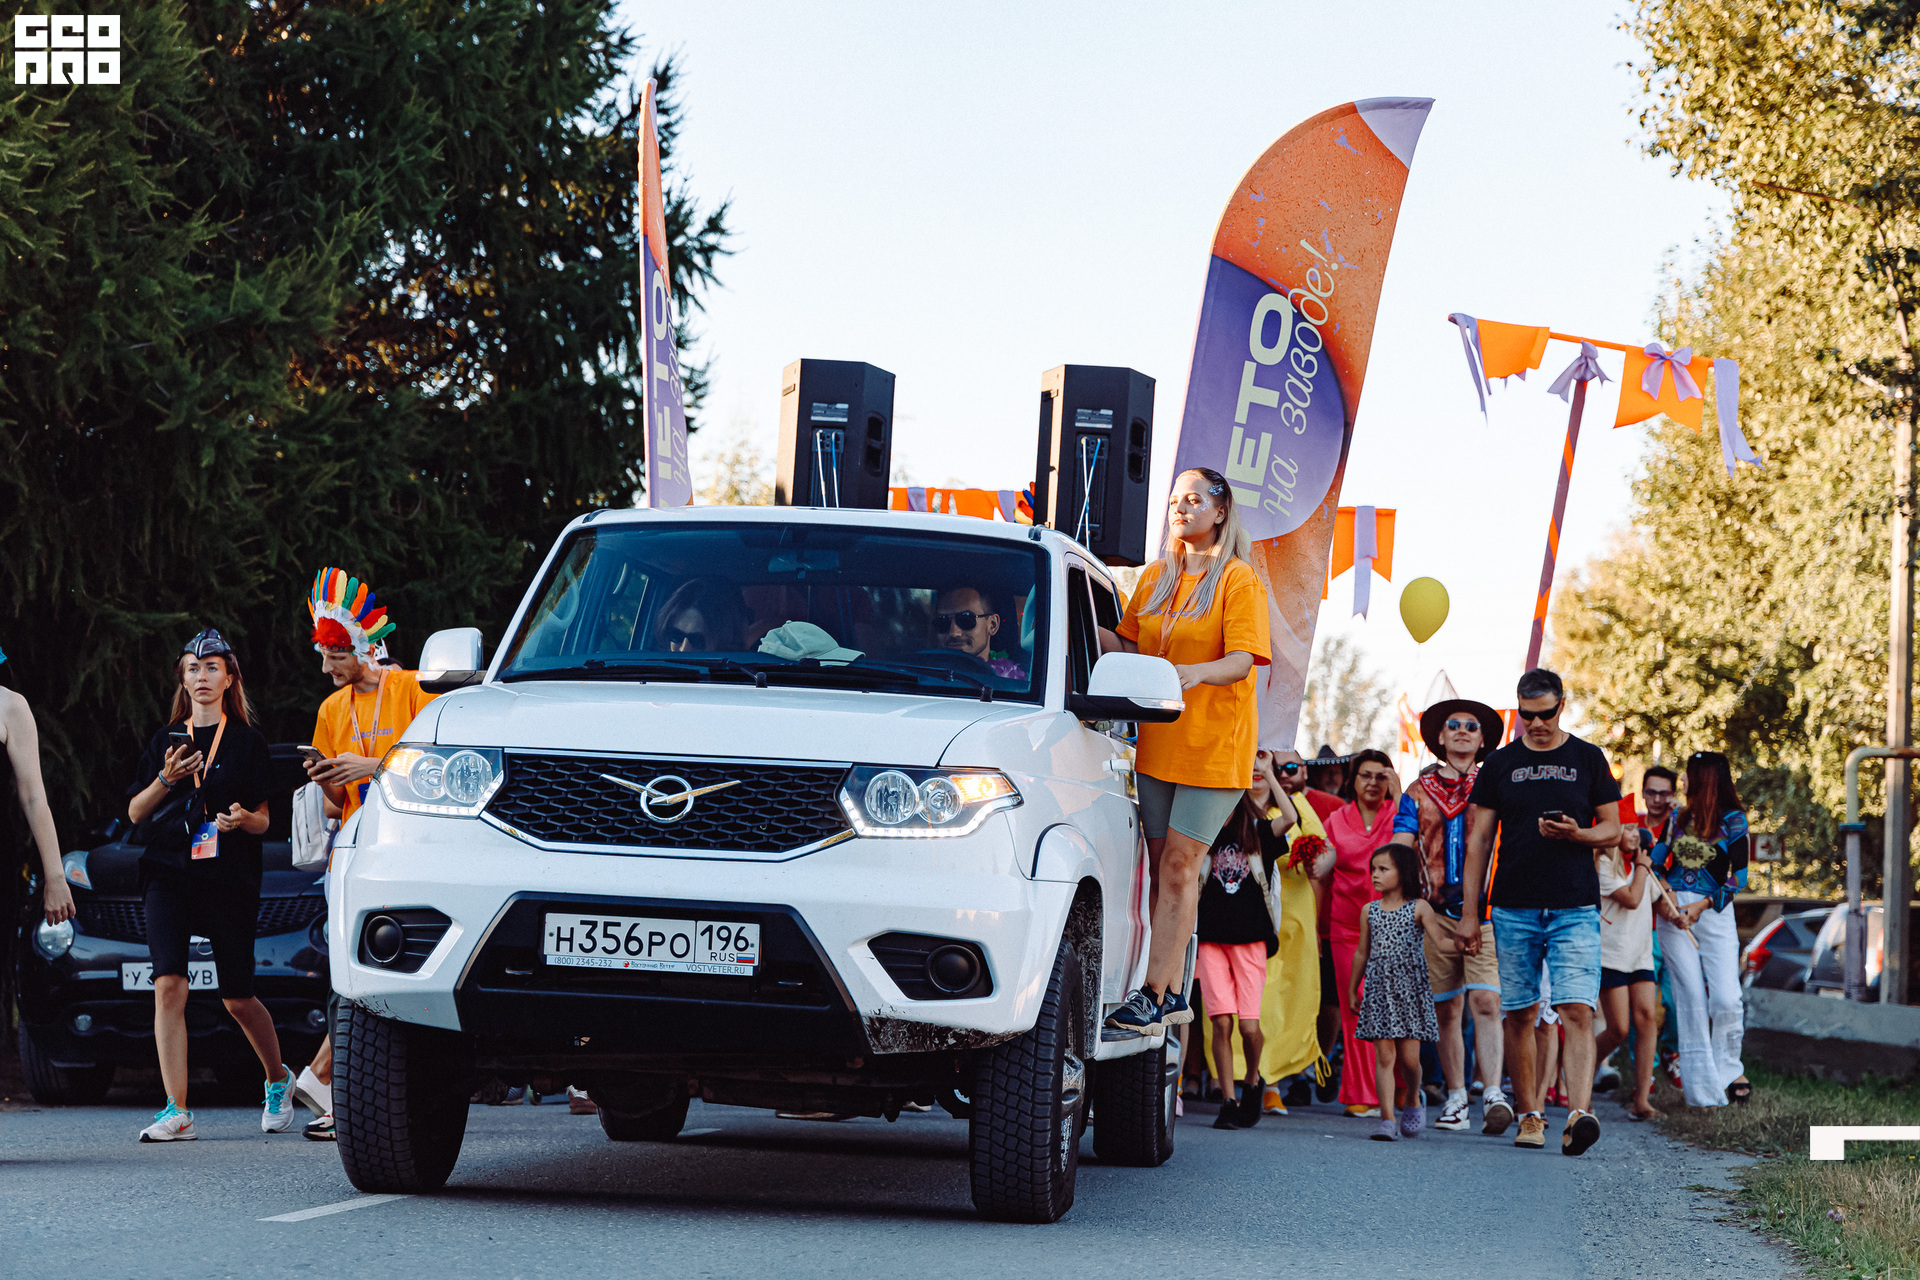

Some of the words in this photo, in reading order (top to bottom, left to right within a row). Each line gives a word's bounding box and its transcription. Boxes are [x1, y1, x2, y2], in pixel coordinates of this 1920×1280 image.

[1280, 238, 1339, 436] заводе!
[1263, 453, 1299, 518] на
[1511, 765, 1577, 783] GURU
[554, 919, 691, 959] Н356РО
[699, 924, 750, 952] 196
[554, 957, 574, 965] (800)
[576, 958, 613, 967] 2345-232
[710, 952, 736, 963] RUS
[686, 963, 746, 975] VOSTVETER.RU
